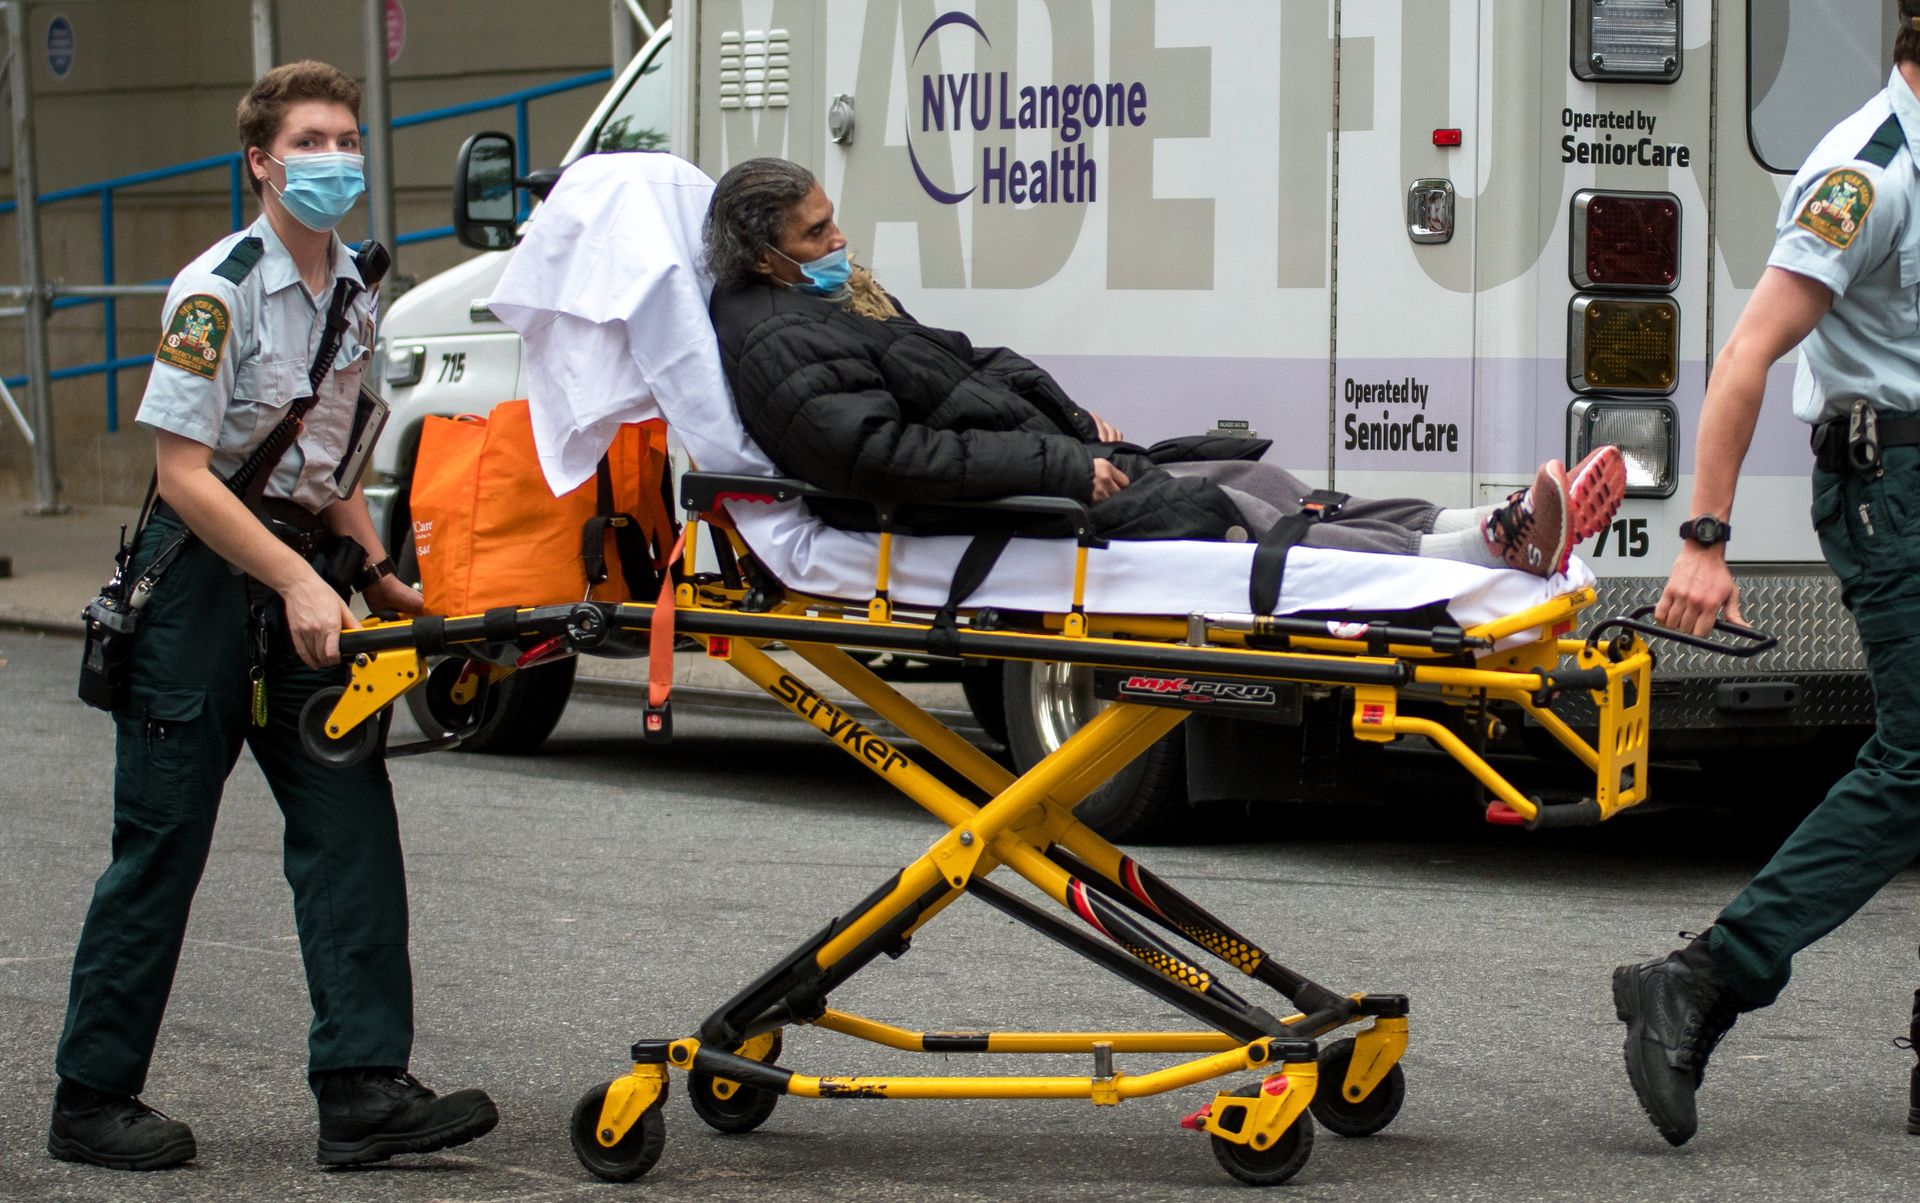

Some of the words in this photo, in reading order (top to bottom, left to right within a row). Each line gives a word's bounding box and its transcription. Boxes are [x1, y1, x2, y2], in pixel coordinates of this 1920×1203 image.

[922, 72, 992, 132] NYU
[1000, 72, 1148, 143] Langone
[1561, 107, 1635, 132] Operated
[1637, 110, 1656, 135] by
[1561, 133, 1690, 167] SeniorCare
[982, 142, 1097, 204] Health
[437, 352, 466, 384] 715
[1344, 377, 1409, 410] Operated
[1411, 377, 1429, 410] by
[1344, 409, 1459, 452] SeniorCare
[1592, 518, 1650, 558] 715
[1125, 675, 1272, 699] MX-PRO
